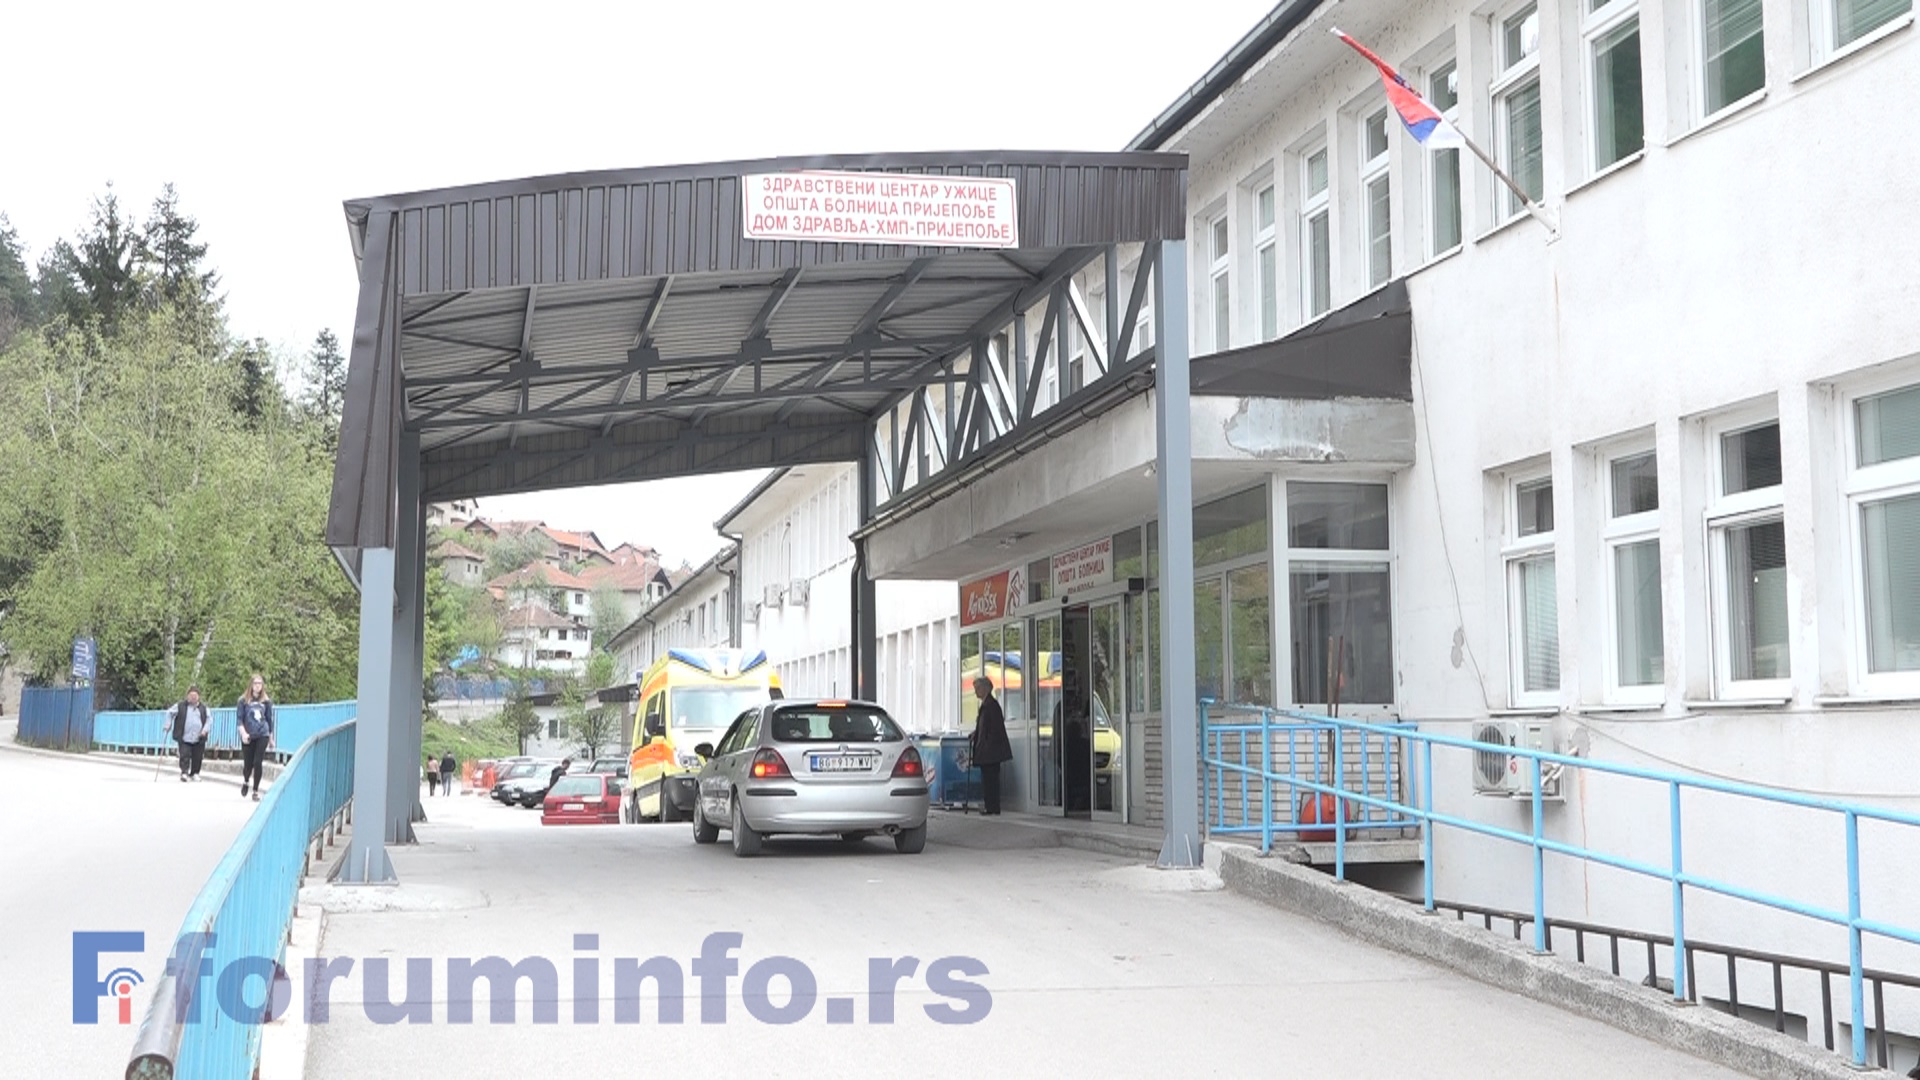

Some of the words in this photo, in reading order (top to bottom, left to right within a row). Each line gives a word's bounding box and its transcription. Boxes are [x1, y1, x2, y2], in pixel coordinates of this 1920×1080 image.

[762, 177, 876, 196] ЗДРАВСТВЕНИ
[880, 182, 939, 199] ЦЕНТАР
[944, 185, 998, 202] УЖИЦЕ
[763, 195, 820, 212] ОПШТА
[824, 197, 899, 217] БОЛНИЦА
[902, 201, 996, 219] ПРИЈЕПОЉЕ
[752, 213, 788, 232] ДОМ
